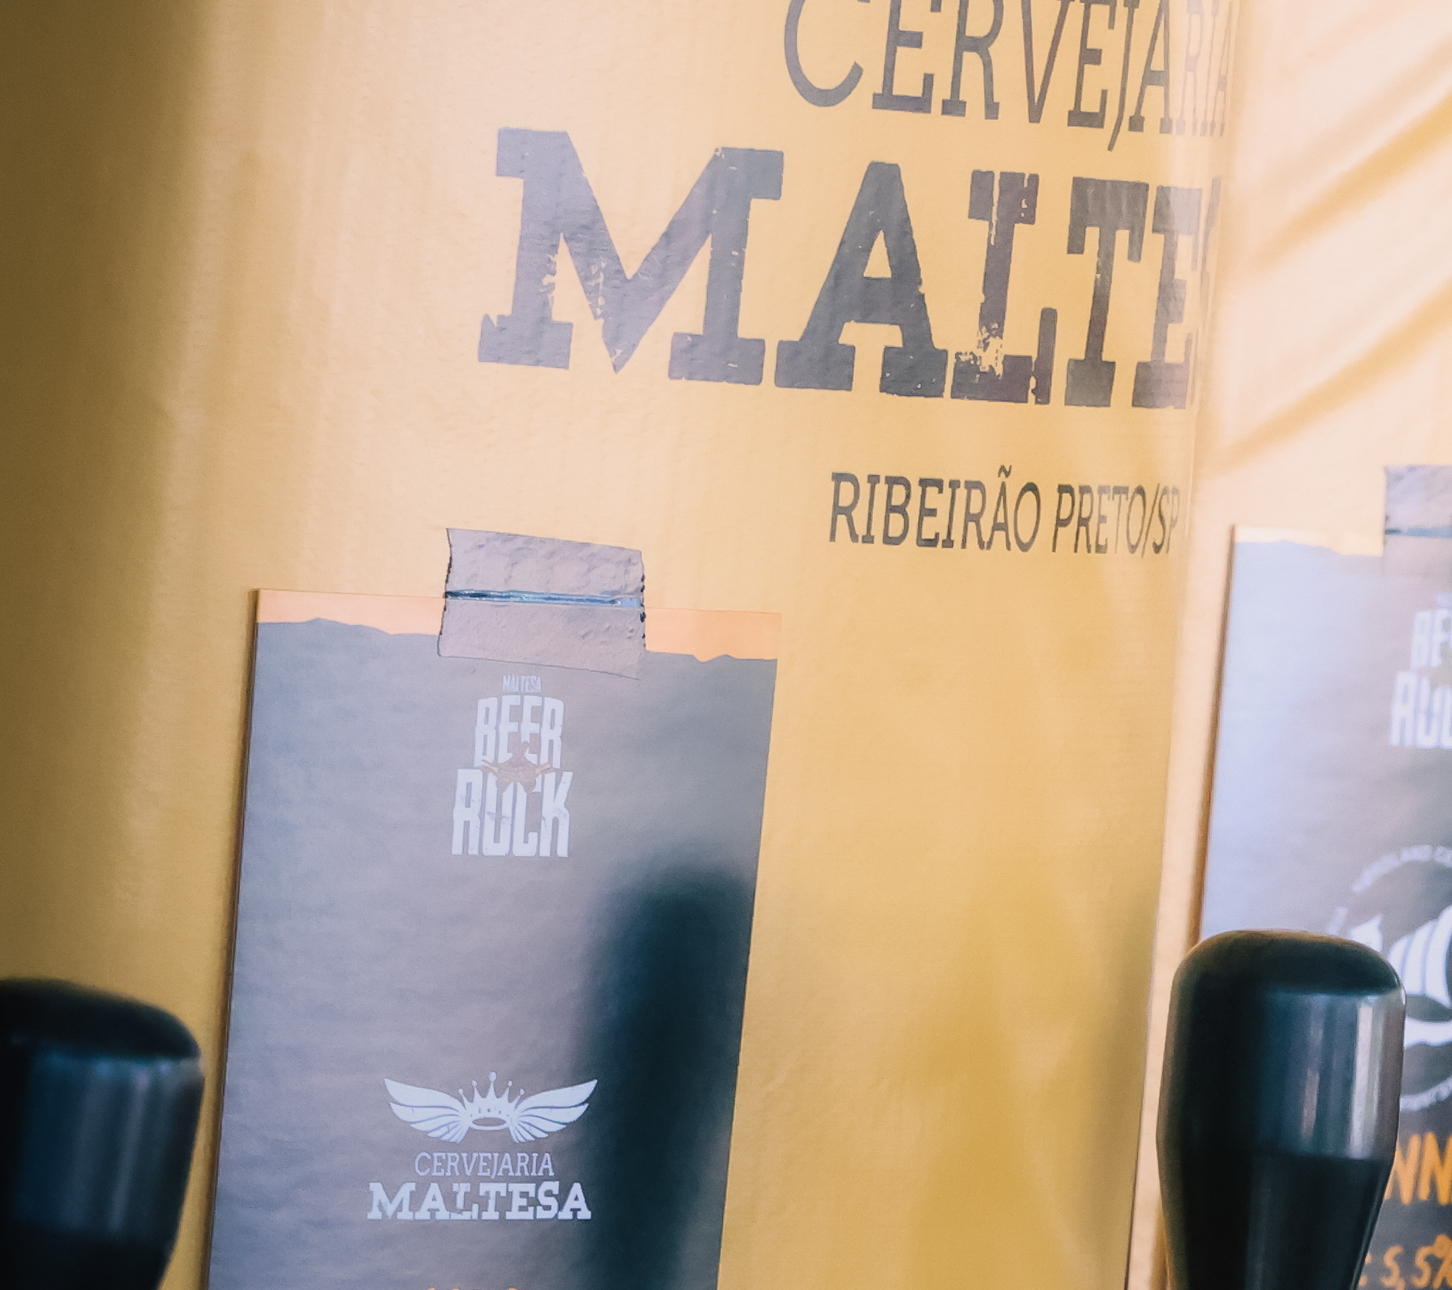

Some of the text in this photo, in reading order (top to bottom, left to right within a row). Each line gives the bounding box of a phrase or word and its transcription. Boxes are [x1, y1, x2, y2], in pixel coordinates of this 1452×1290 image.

[477, 127, 1221, 409] MALTE
[829, 465, 1041, 552] RIBEIRÃO
[474, 695, 564, 769] BEER
[367, 1182, 592, 1220] MALTESA
[414, 1152, 555, 1180] CERVEJARIA
